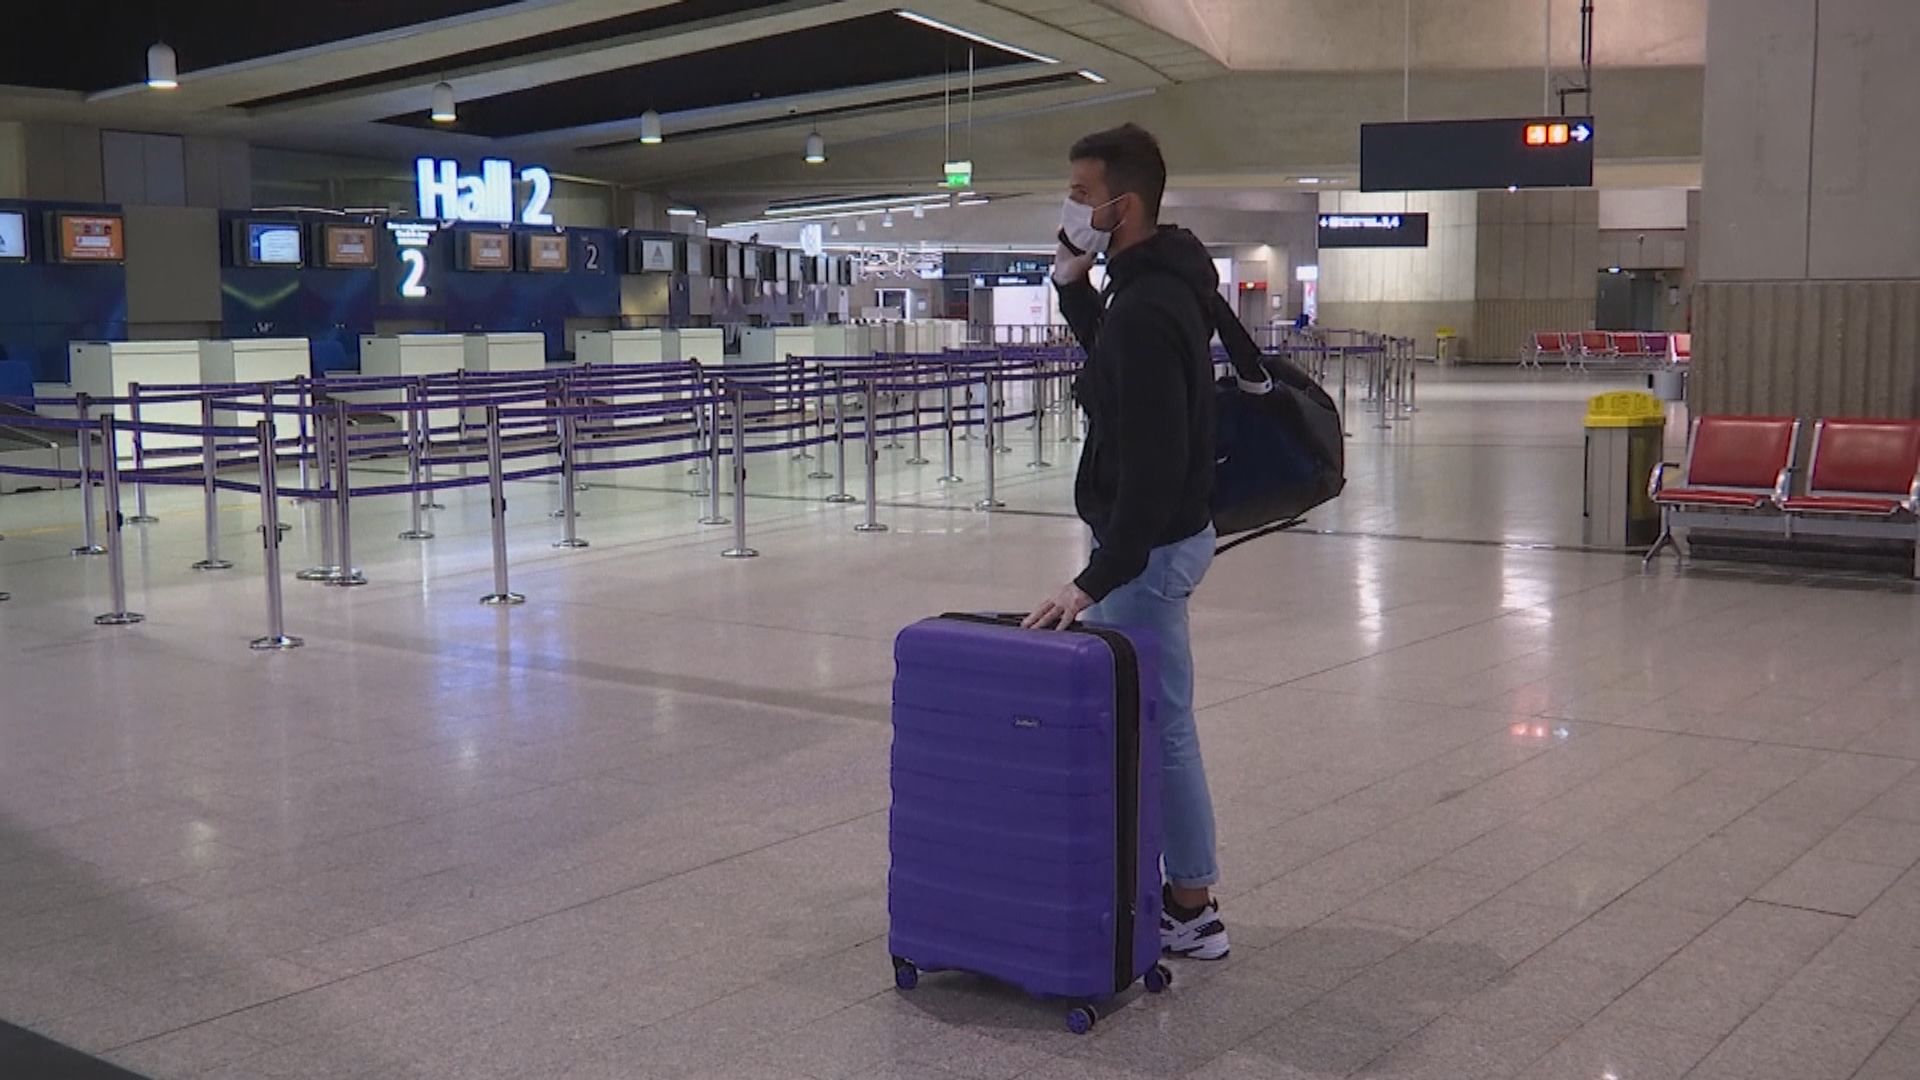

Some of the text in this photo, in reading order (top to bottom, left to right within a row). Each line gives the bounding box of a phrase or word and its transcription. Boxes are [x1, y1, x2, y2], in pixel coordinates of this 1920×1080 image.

[417, 158, 553, 225] Hall 2
[401, 248, 427, 297] 2
[586, 245, 598, 270] 2
